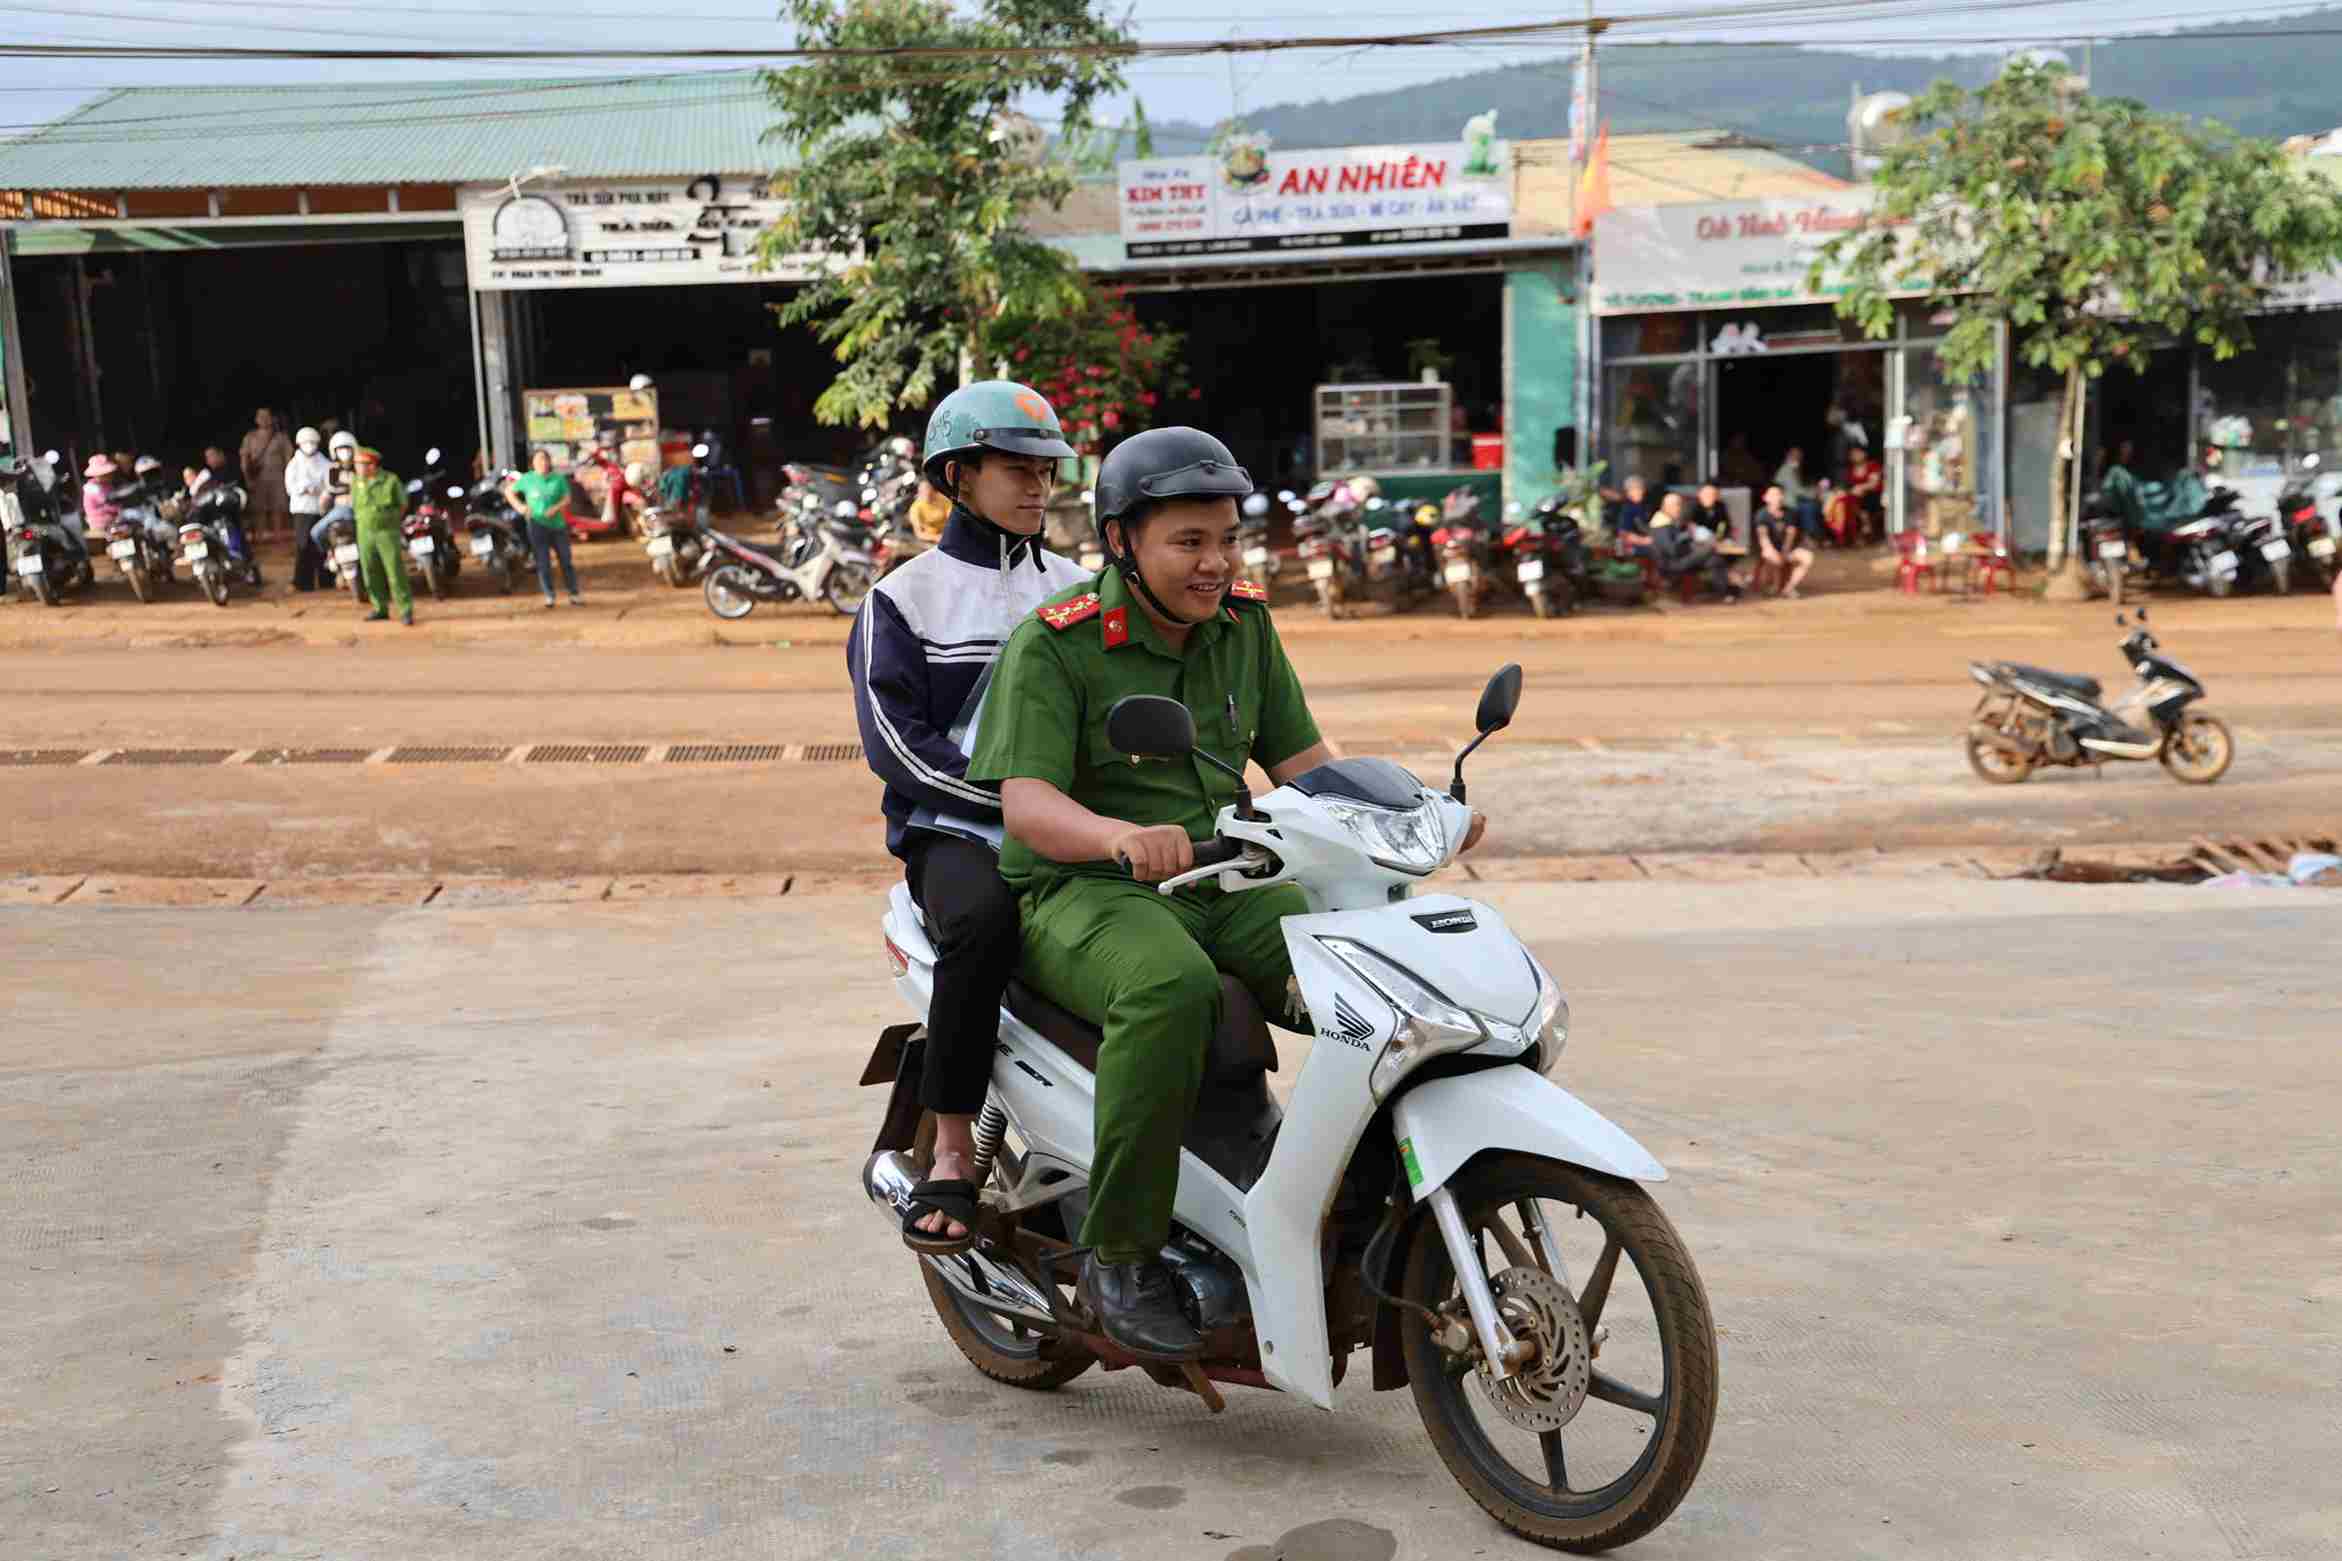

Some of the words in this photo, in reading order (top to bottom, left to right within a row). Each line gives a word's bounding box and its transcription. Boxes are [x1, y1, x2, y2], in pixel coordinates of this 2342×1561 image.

[1279, 166, 1328, 196] AN
[1339, 155, 1447, 193] NHIÊN
[1320, 1026, 1371, 1052] HONDA
